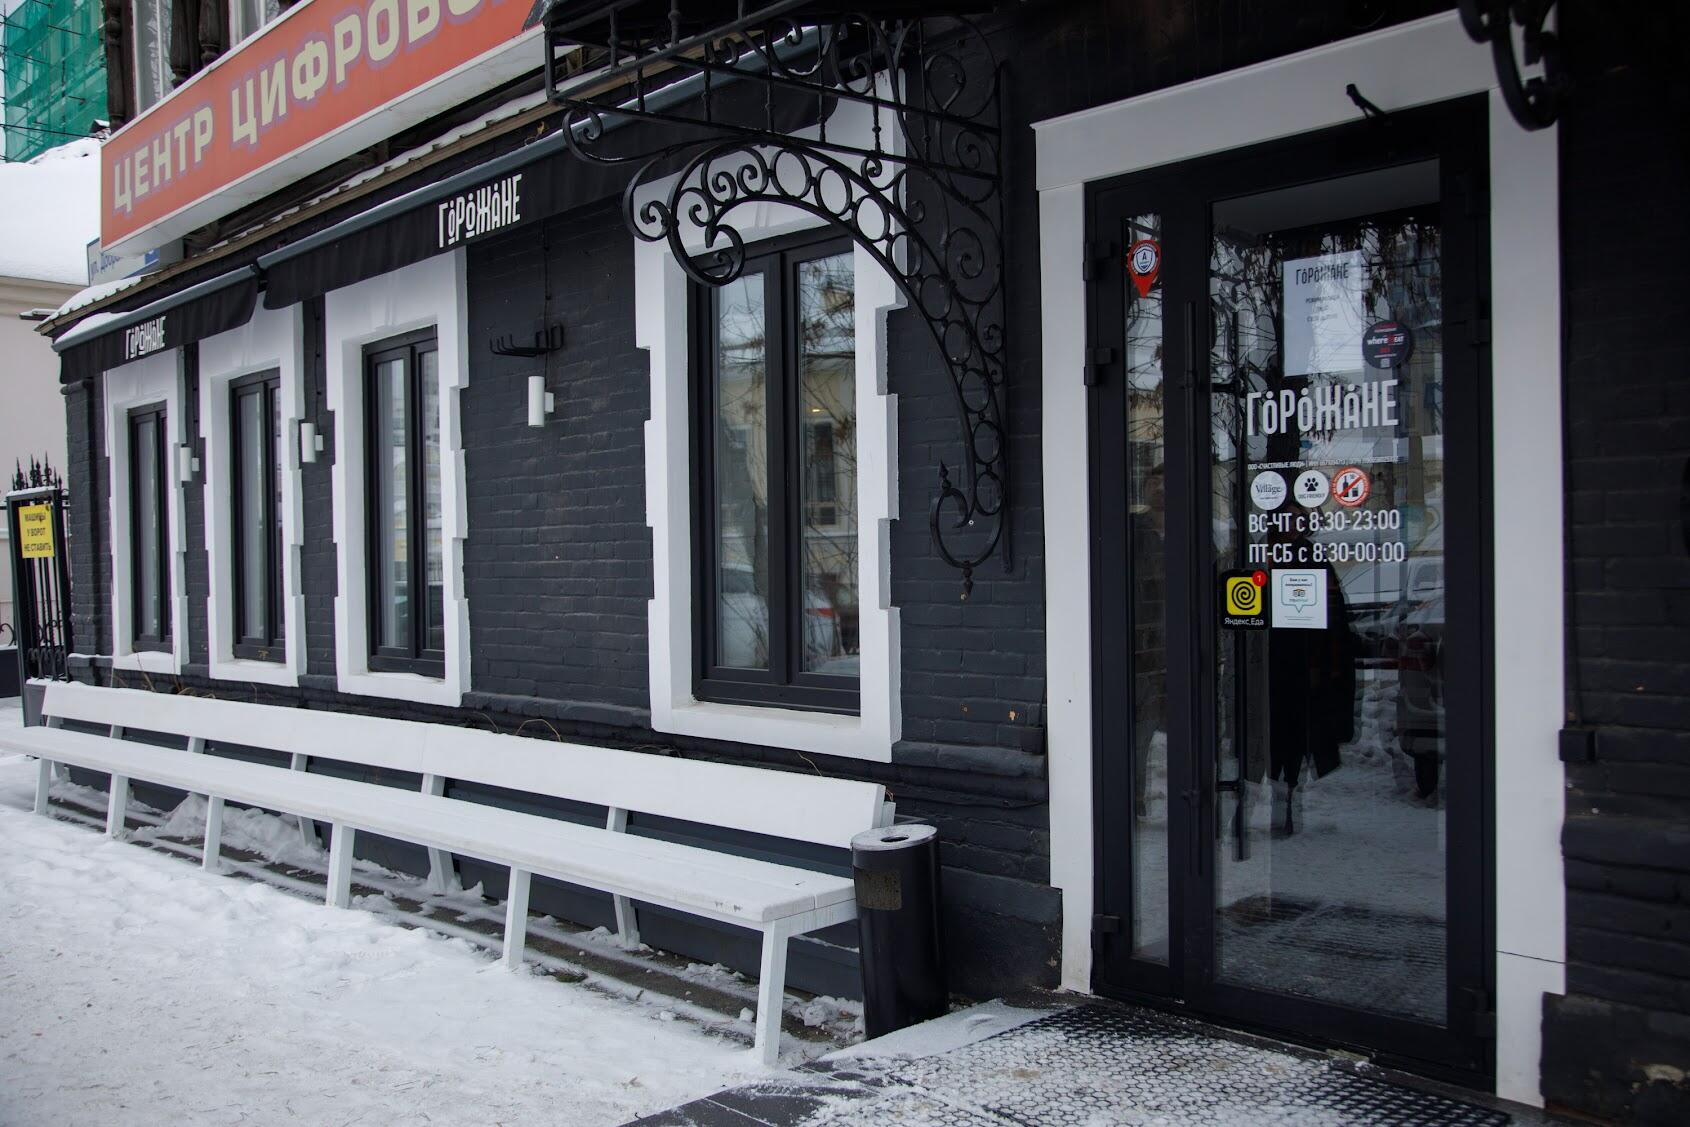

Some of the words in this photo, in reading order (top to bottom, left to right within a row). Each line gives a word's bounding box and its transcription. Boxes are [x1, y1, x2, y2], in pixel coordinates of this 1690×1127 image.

[113, 107, 214, 213] ЦЕНТР
[231, 0, 481, 145] ЦИФРОВ
[439, 174, 522, 248] ГОРОЖАНЕ
[125, 316, 166, 360] ГОРОЖАНЕ
[1247, 379, 1398, 436] ГОРОЖАНЕ
[1249, 512, 1292, 533] ВС-ЧТ
[1309, 509, 1400, 532] 8:30-23:00
[1249, 543, 1292, 563] ПТ-СБ
[1312, 542, 1405, 563] 8:30-00:00
